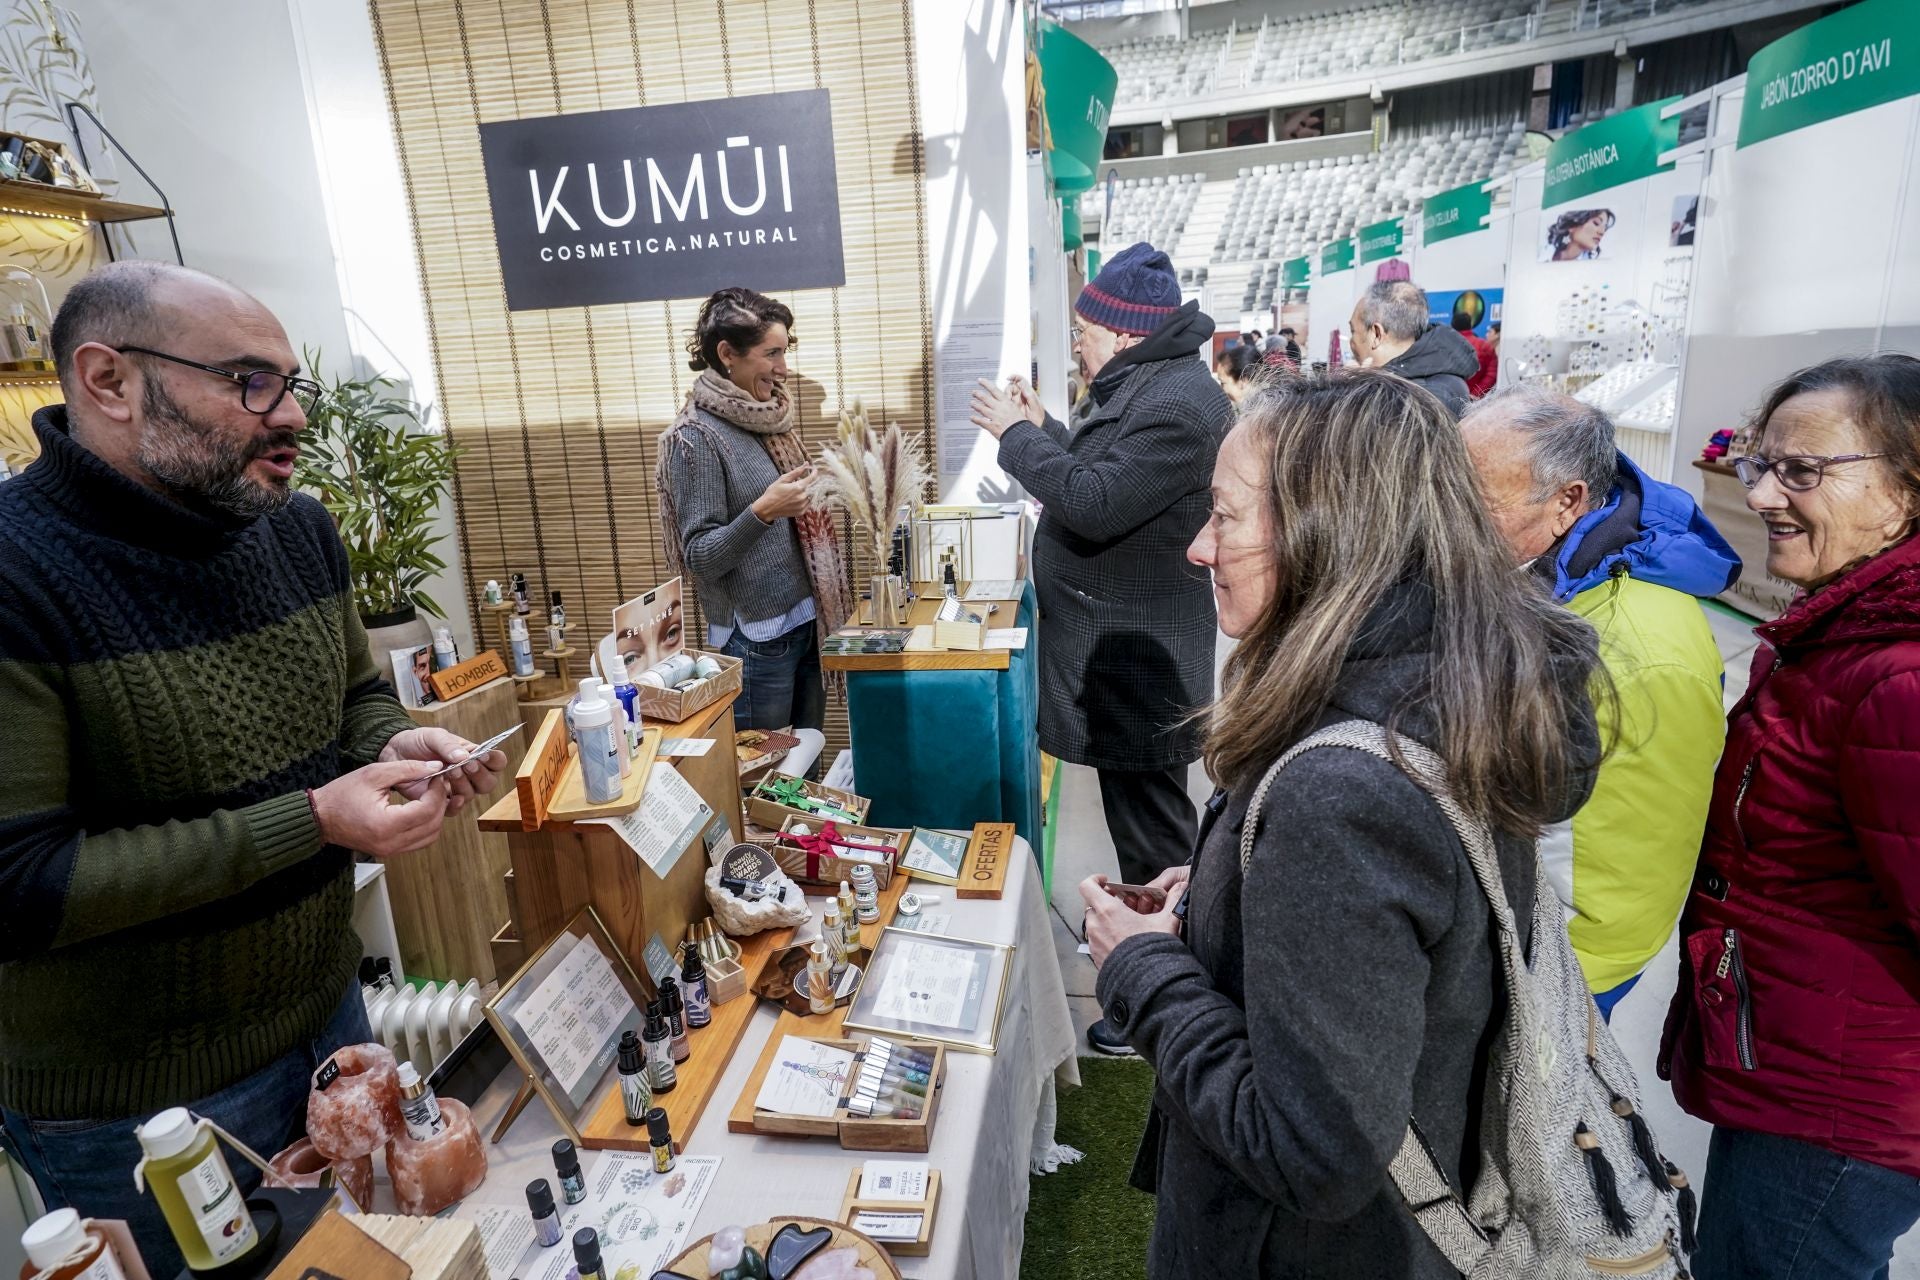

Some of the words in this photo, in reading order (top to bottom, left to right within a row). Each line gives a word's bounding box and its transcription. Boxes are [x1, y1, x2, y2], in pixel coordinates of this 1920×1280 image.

[1761, 72, 1790, 110] JABÓN
[1791, 56, 1839, 99] ZORRO
[1574, 143, 1620, 177] BOTÁNICA
[540, 227, 799, 263] COSMETICA.NATURAL
[626, 623, 645, 640] SET
[444, 659, 499, 693] HOMBRE
[538, 737, 566, 810] FACIAL
[728, 851, 752, 869] beauty
[729, 854, 759, 876] shortlist
[972, 829, 1003, 881] OFERTAS
[597, 1041, 618, 1067] CREMAS
[611, 1153, 650, 1162] EUCALIPTO
[629, 1217, 643, 1232] BIO
